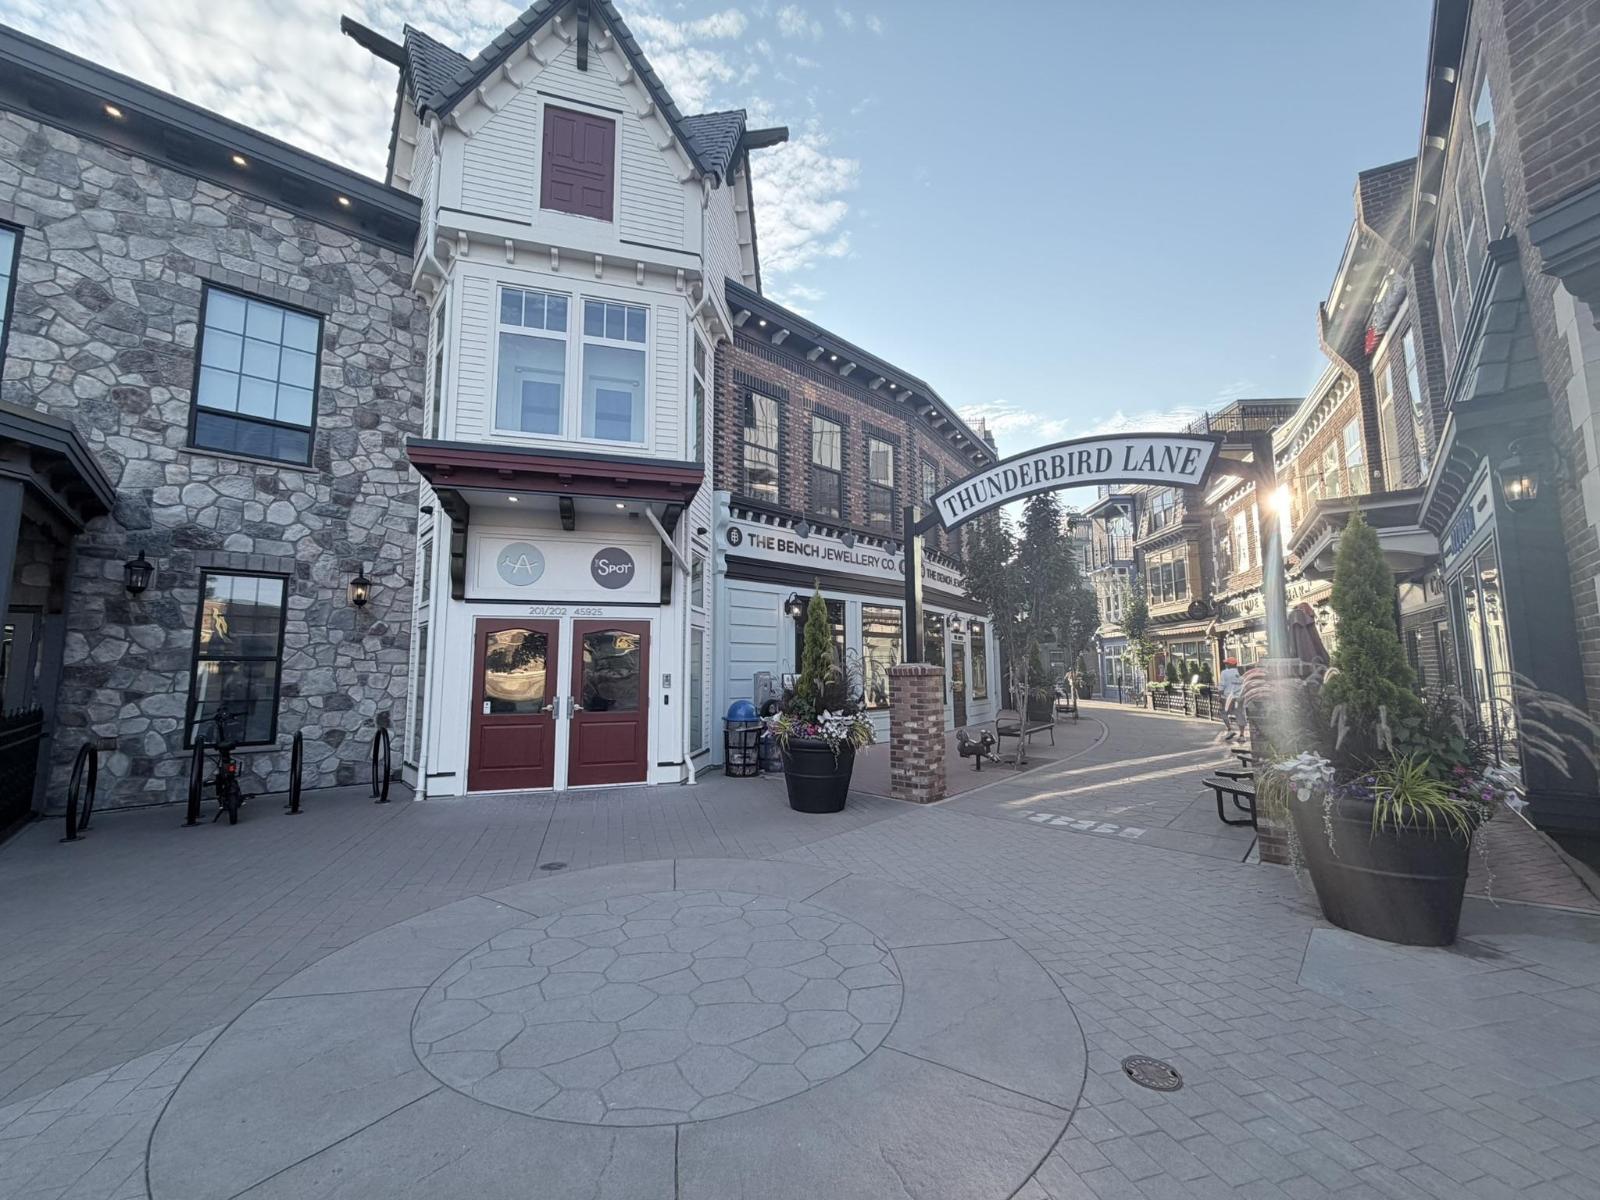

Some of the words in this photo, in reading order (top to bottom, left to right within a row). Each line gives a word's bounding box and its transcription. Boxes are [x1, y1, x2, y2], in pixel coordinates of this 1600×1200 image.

[943, 447, 1112, 518] THUNDERBIRD
[1122, 445, 1202, 476] LANE
[748, 533, 775, 550] THE
[777, 538, 819, 558] BENCH
[821, 547, 880, 567] JEWELLERY
[881, 557, 897, 572] CO.
[926, 568, 938, 581] THE
[528, 606, 568, 616] 201/202
[574, 607, 604, 616] 45925
